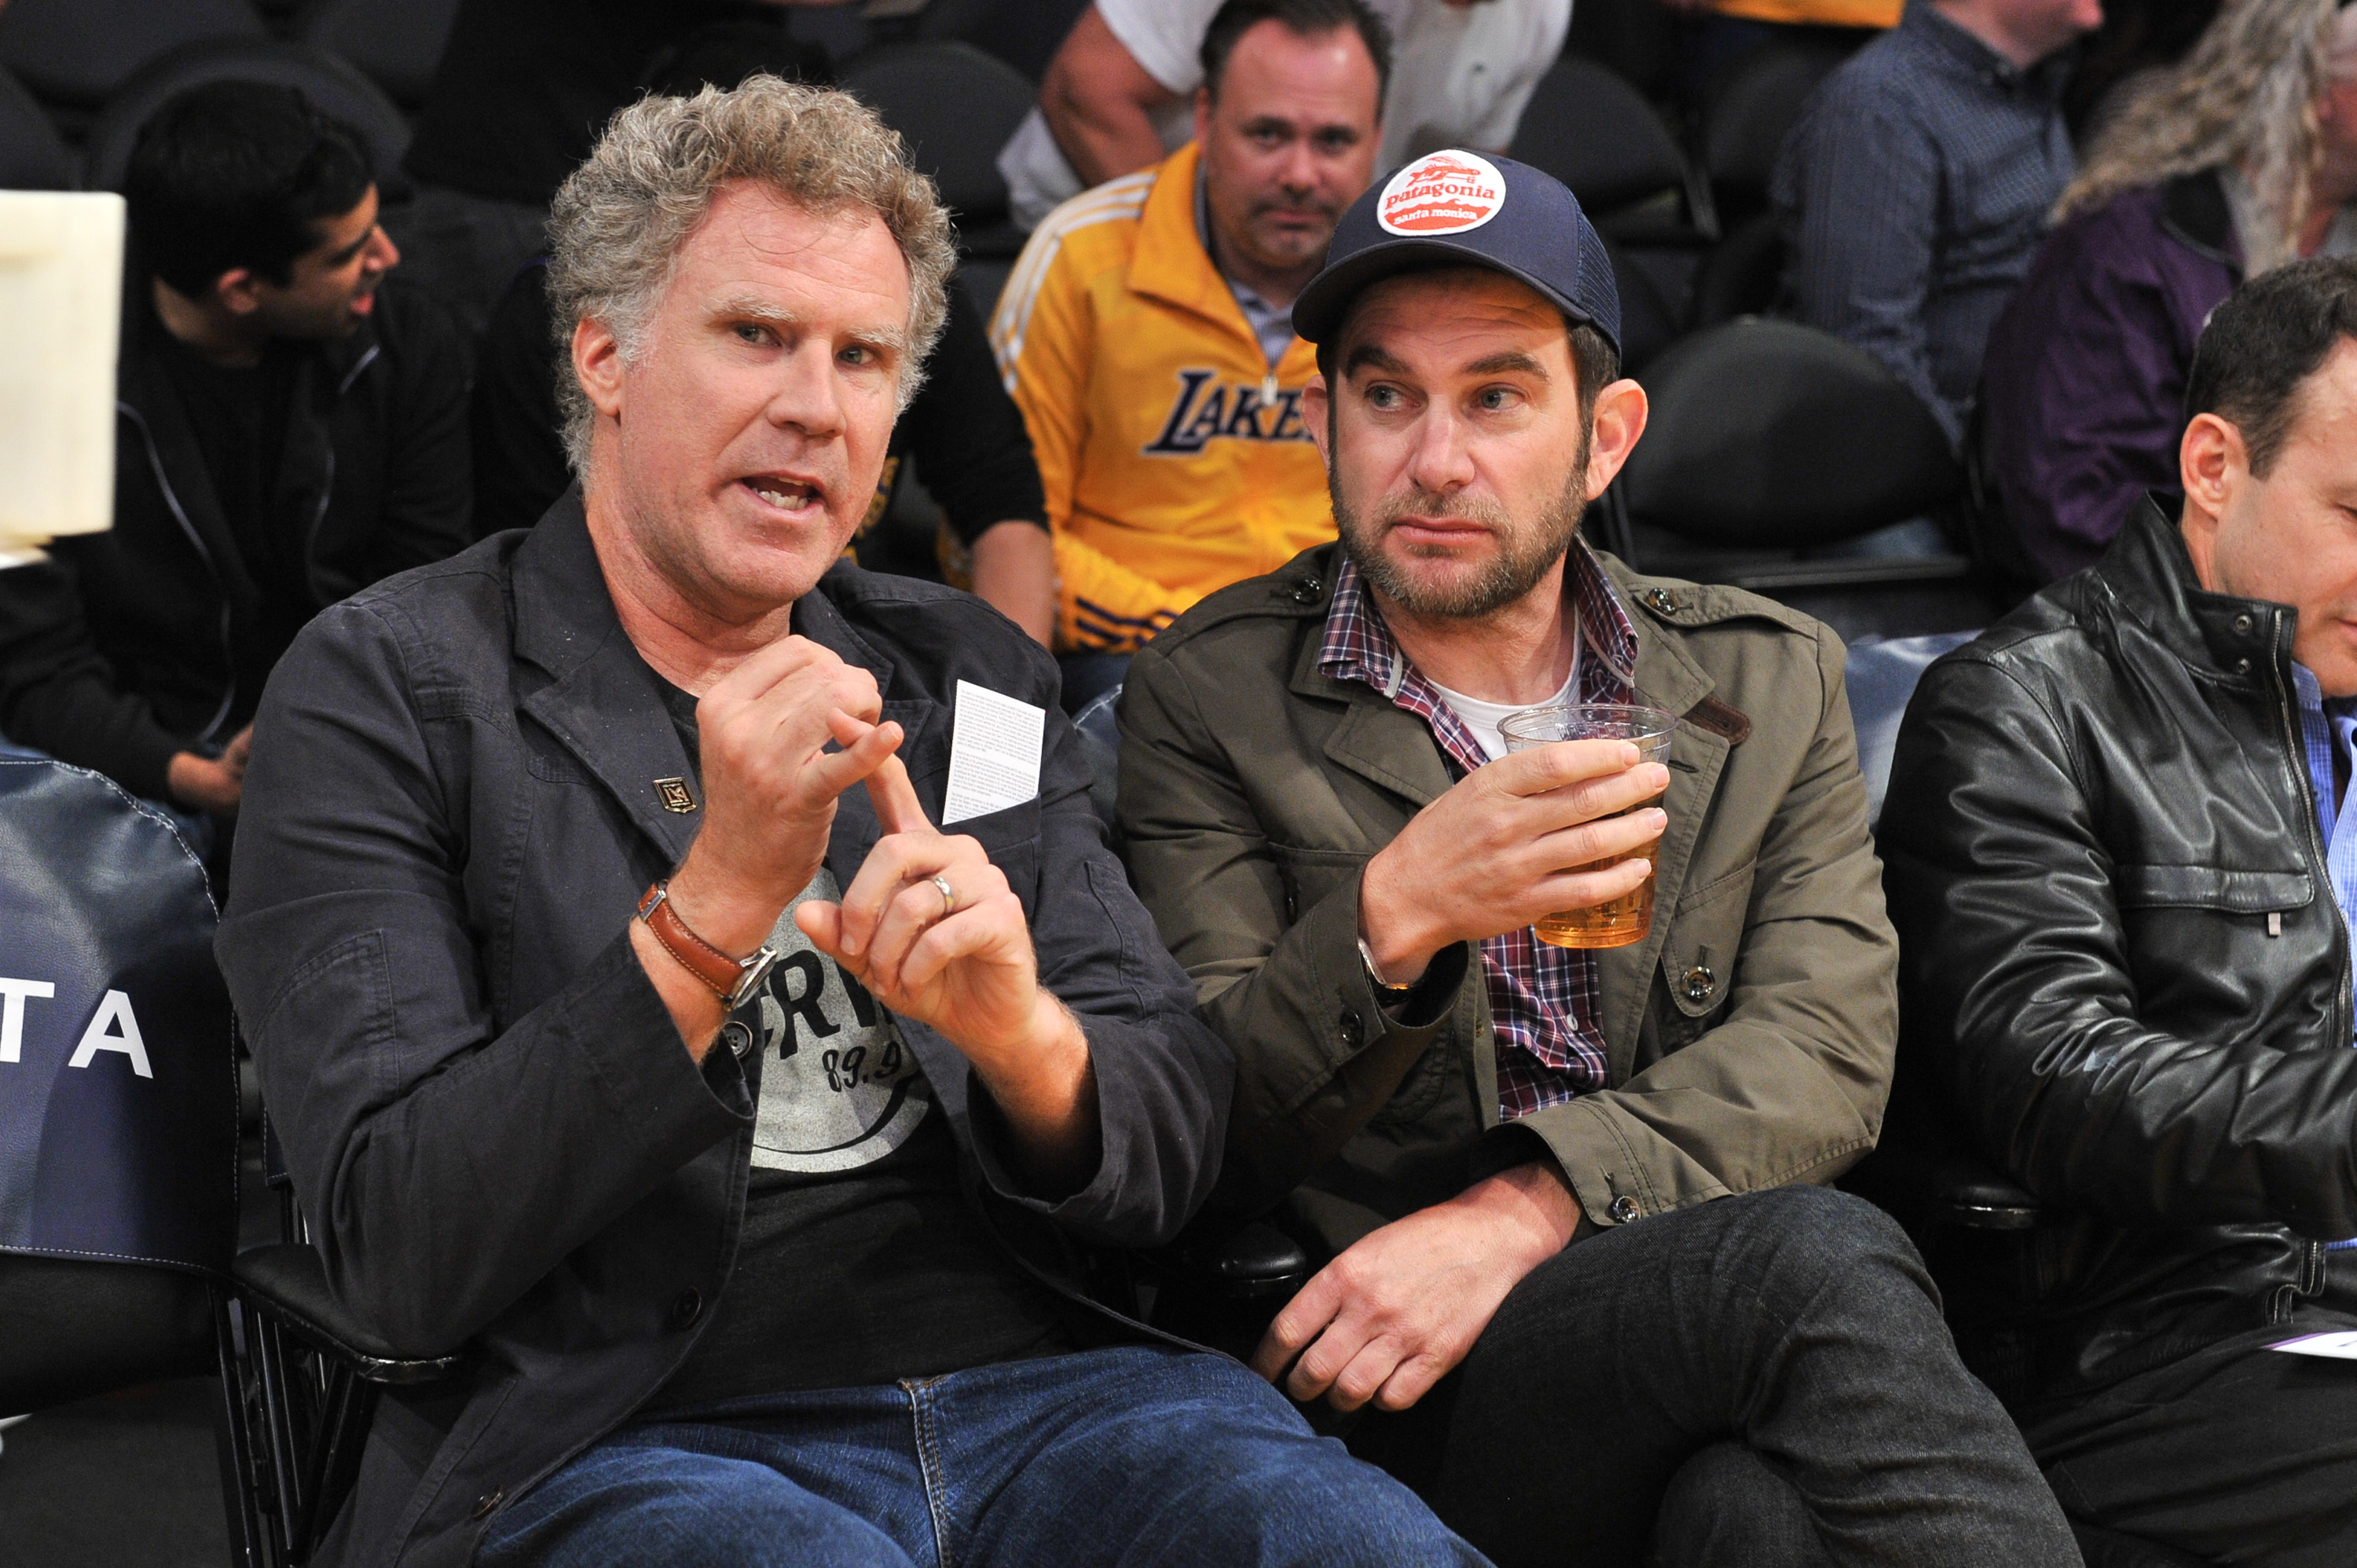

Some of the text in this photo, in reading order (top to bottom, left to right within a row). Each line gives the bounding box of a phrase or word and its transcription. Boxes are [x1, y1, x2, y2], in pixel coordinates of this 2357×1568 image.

[1385, 182, 1496, 210] patagonia
[1393, 207, 1477, 225] santa monica
[822, 1040, 902, 1093] 89.9
